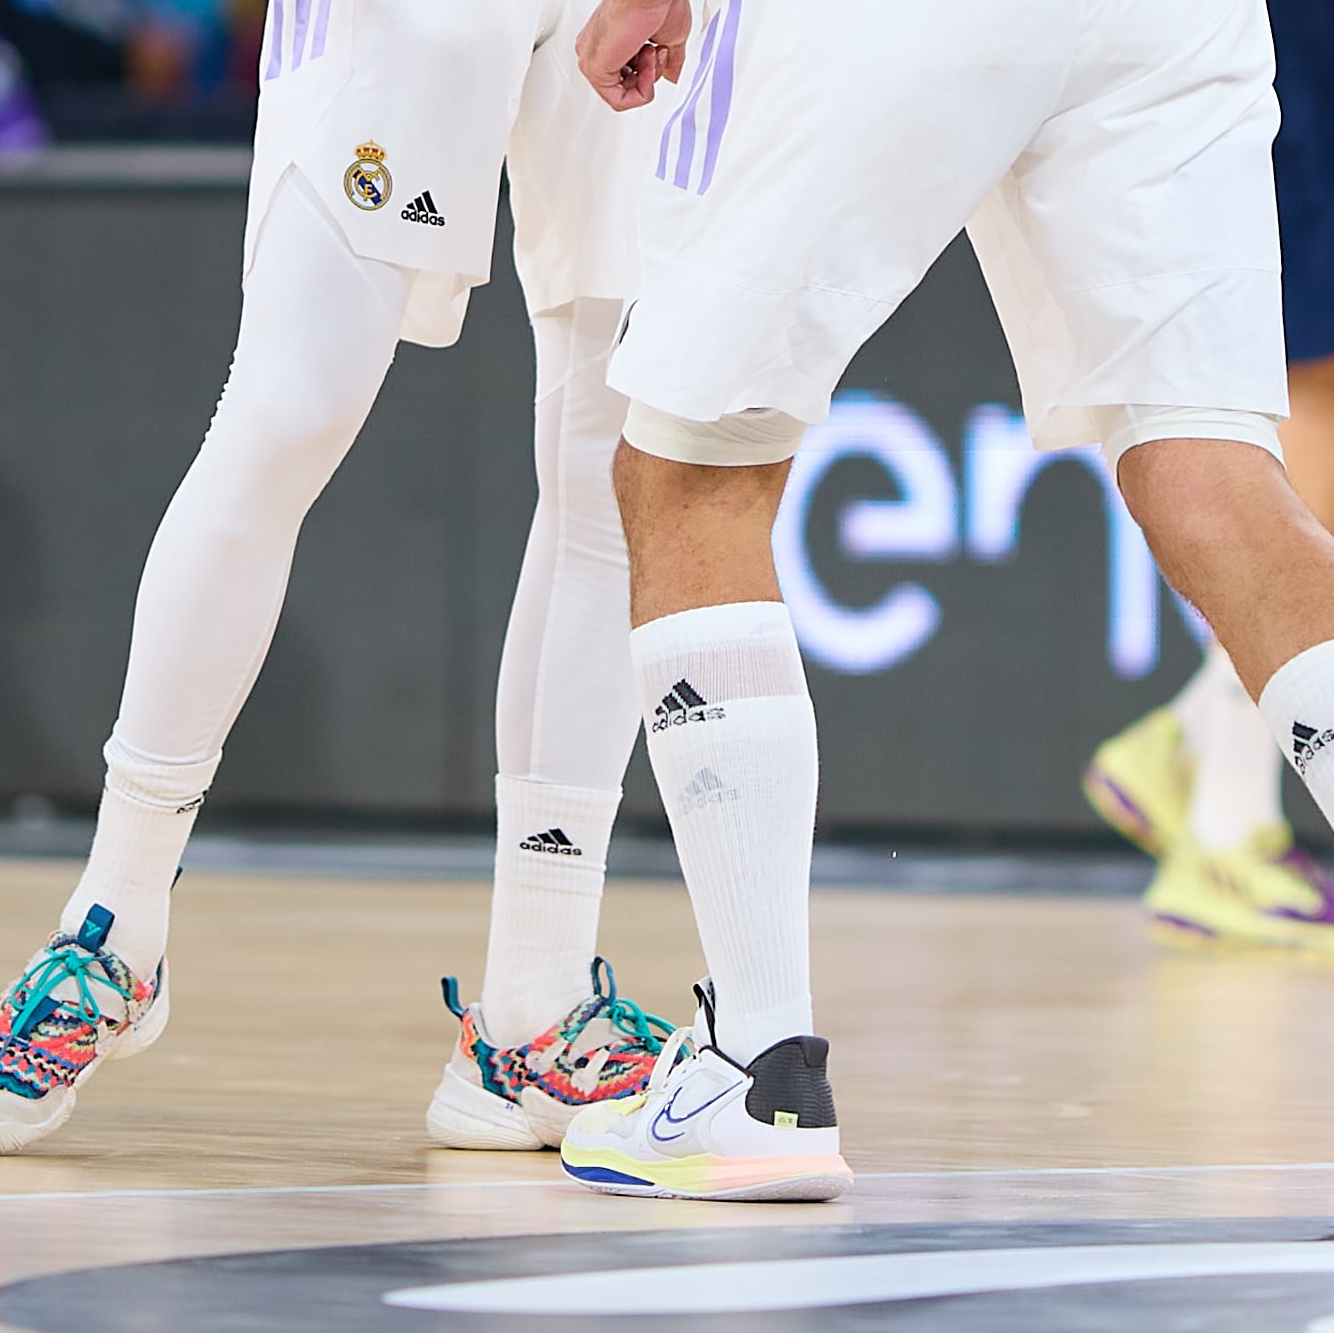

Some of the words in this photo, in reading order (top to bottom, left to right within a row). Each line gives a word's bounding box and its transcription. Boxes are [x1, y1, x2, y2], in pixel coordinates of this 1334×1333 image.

[400, 209, 446, 227] adidas
[652, 707, 727, 733] adidas
[519, 841, 583, 856] adidas
